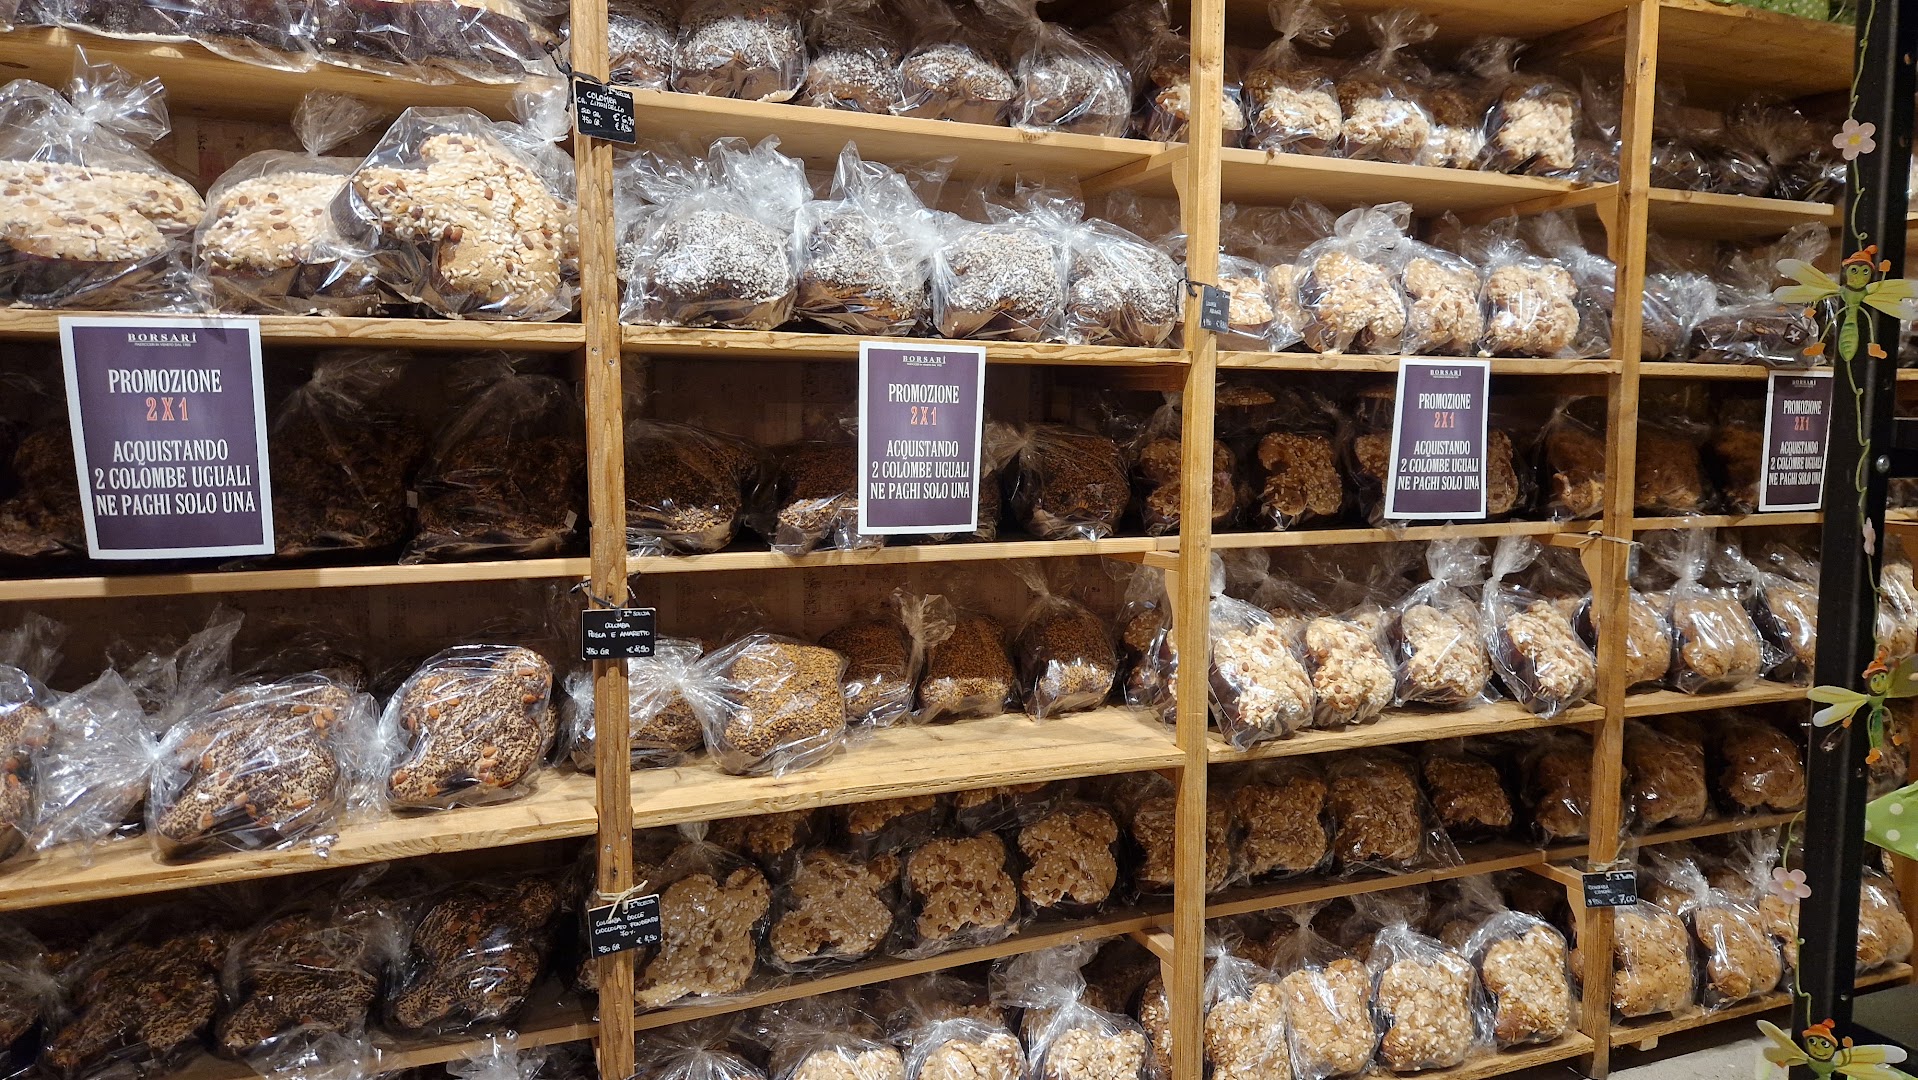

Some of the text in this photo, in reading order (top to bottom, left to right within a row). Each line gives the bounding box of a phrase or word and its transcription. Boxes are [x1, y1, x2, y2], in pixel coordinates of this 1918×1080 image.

[586, 91, 617, 104] COLOMBA
[590, 100, 624, 113] LIMONCELLO
[108, 369, 222, 393] PROMOZIONE
[889, 384, 959, 403] PROMOZIONE
[1419, 393, 1470, 409] PROMOZIONE
[1784, 400, 1822, 414] PROMOZIONE
[113, 439, 228, 465] ACQUISTANDO
[886, 440, 959, 459] ACQUISTANDO
[1414, 441, 1470, 457] ACQUISTANDO
[1780, 442, 1818, 456] ACQUISTANDO
[872, 461, 969, 478] 2 COLOMBE UGUALI
[1400, 458, 1478, 472] 2 COLOMBE UGUALI
[1771, 456, 1822, 470] 2 COLOMBE UGUALI
[95, 465, 251, 489] 2 COLOMBE UGUALI
[1398, 476, 1479, 490] NE PAGHI SOLO UNA
[1769, 473, 1778, 485] NE
[1779, 472, 1797, 485] PAGHI
[1798, 472, 1811, 485] SOLO
[870, 482, 969, 499] NE PAGHI SOLO UNA
[96, 491, 256, 516] NE PAGHI SOLO UNA
[1618, 894, 1635, 904] 7,00
